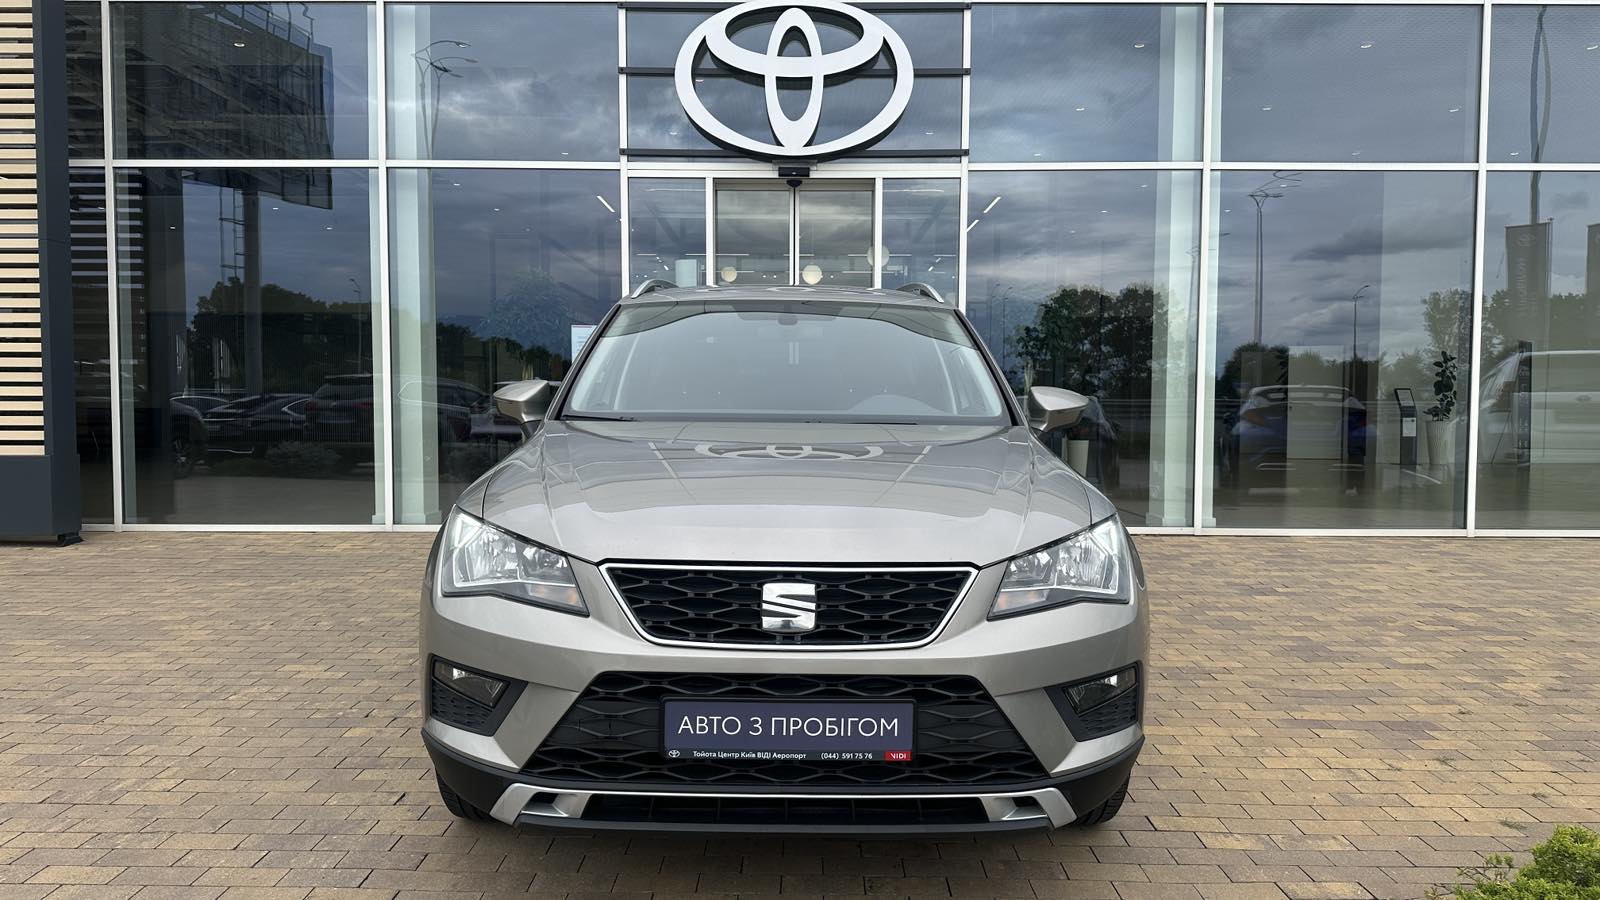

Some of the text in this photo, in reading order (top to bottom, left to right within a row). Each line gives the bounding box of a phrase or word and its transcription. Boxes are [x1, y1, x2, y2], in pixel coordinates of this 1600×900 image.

[677, 715, 742, 735] АВТО
[771, 717, 898, 737] ПРОБІГОМ
[693, 750, 717, 758] Тойота
[717, 751, 740, 759] Центр
[757, 752, 771, 760] ВІДІ
[772, 752, 807, 760] Аеропорт
[821, 752, 839, 760] (044)
[864, 752, 873, 760] 76
